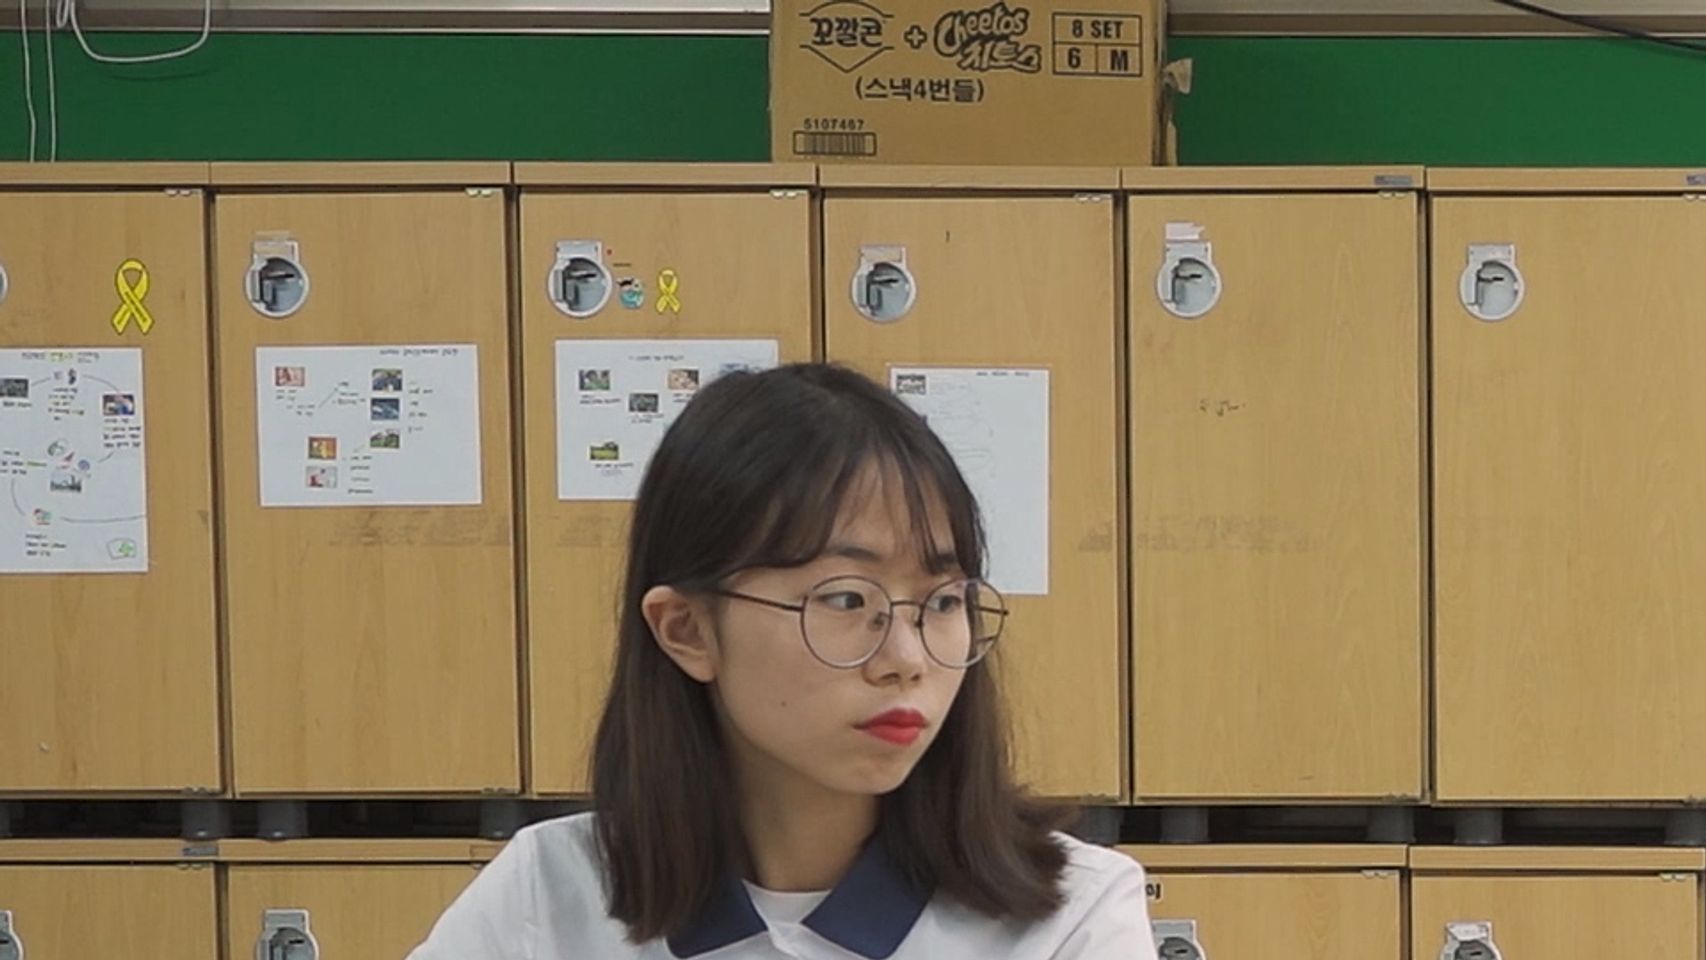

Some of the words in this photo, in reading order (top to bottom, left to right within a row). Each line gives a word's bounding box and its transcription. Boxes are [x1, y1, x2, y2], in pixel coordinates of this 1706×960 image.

[810, 17, 883, 47] 꼬깔콘
[934, 1, 1030, 57] Cheetos
[1072, 20, 1083, 38] 8
[1090, 20, 1123, 39] SET
[957, 40, 1041, 73] 치토스
[1067, 48, 1081, 69] 6
[1110, 51, 1128, 71] M
[855, 76, 984, 102] (스낵4번들)
